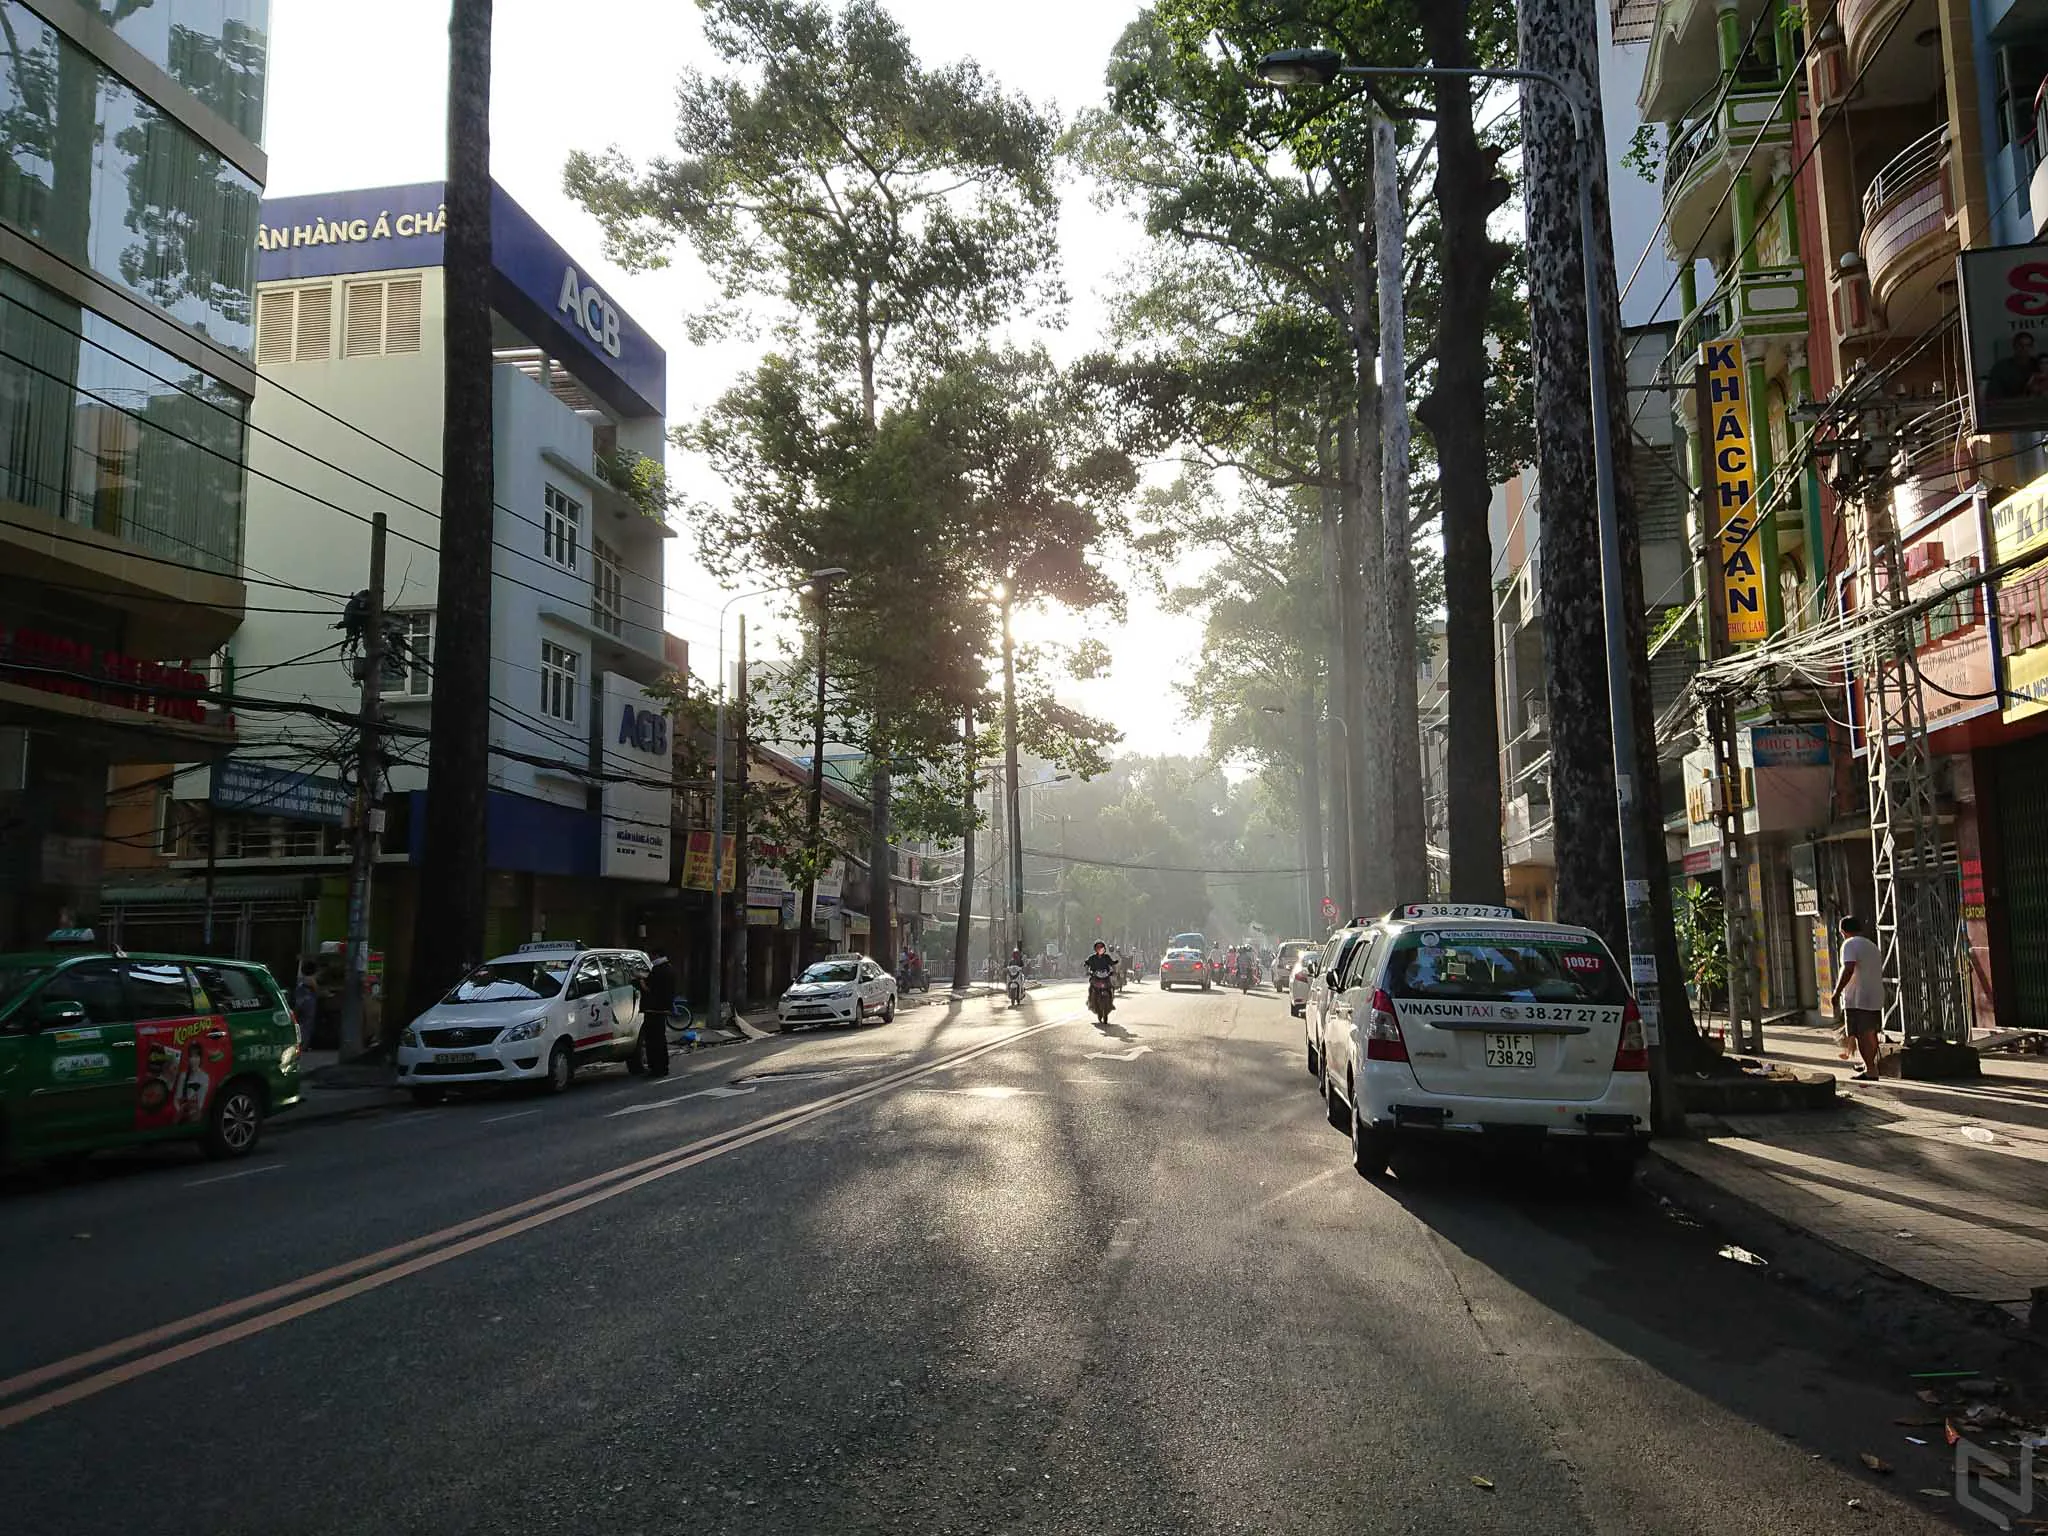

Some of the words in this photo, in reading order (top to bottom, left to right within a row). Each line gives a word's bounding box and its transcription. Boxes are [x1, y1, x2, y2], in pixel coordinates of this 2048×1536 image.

[293, 217, 368, 246] HÀNG
[372, 210, 392, 239] Á
[558, 265, 622, 359] ACB
[1707, 343, 1749, 507] KHÁCH
[1725, 517, 1758, 614] SẠN
[618, 703, 668, 756] ACB
[1431, 906, 1469, 917] 38.27
[1474, 907, 1488, 917] 27
[1495, 908, 1509, 918] 27
[1563, 956, 1600, 969] 10027
[1525, 1006, 1571, 1021] 38.27
[1577, 1009, 1596, 1022] 27
[1602, 1011, 1620, 1024] 27
[174, 1018, 212, 1046] KORENO
[1496, 1033, 1521, 1049] 51F
